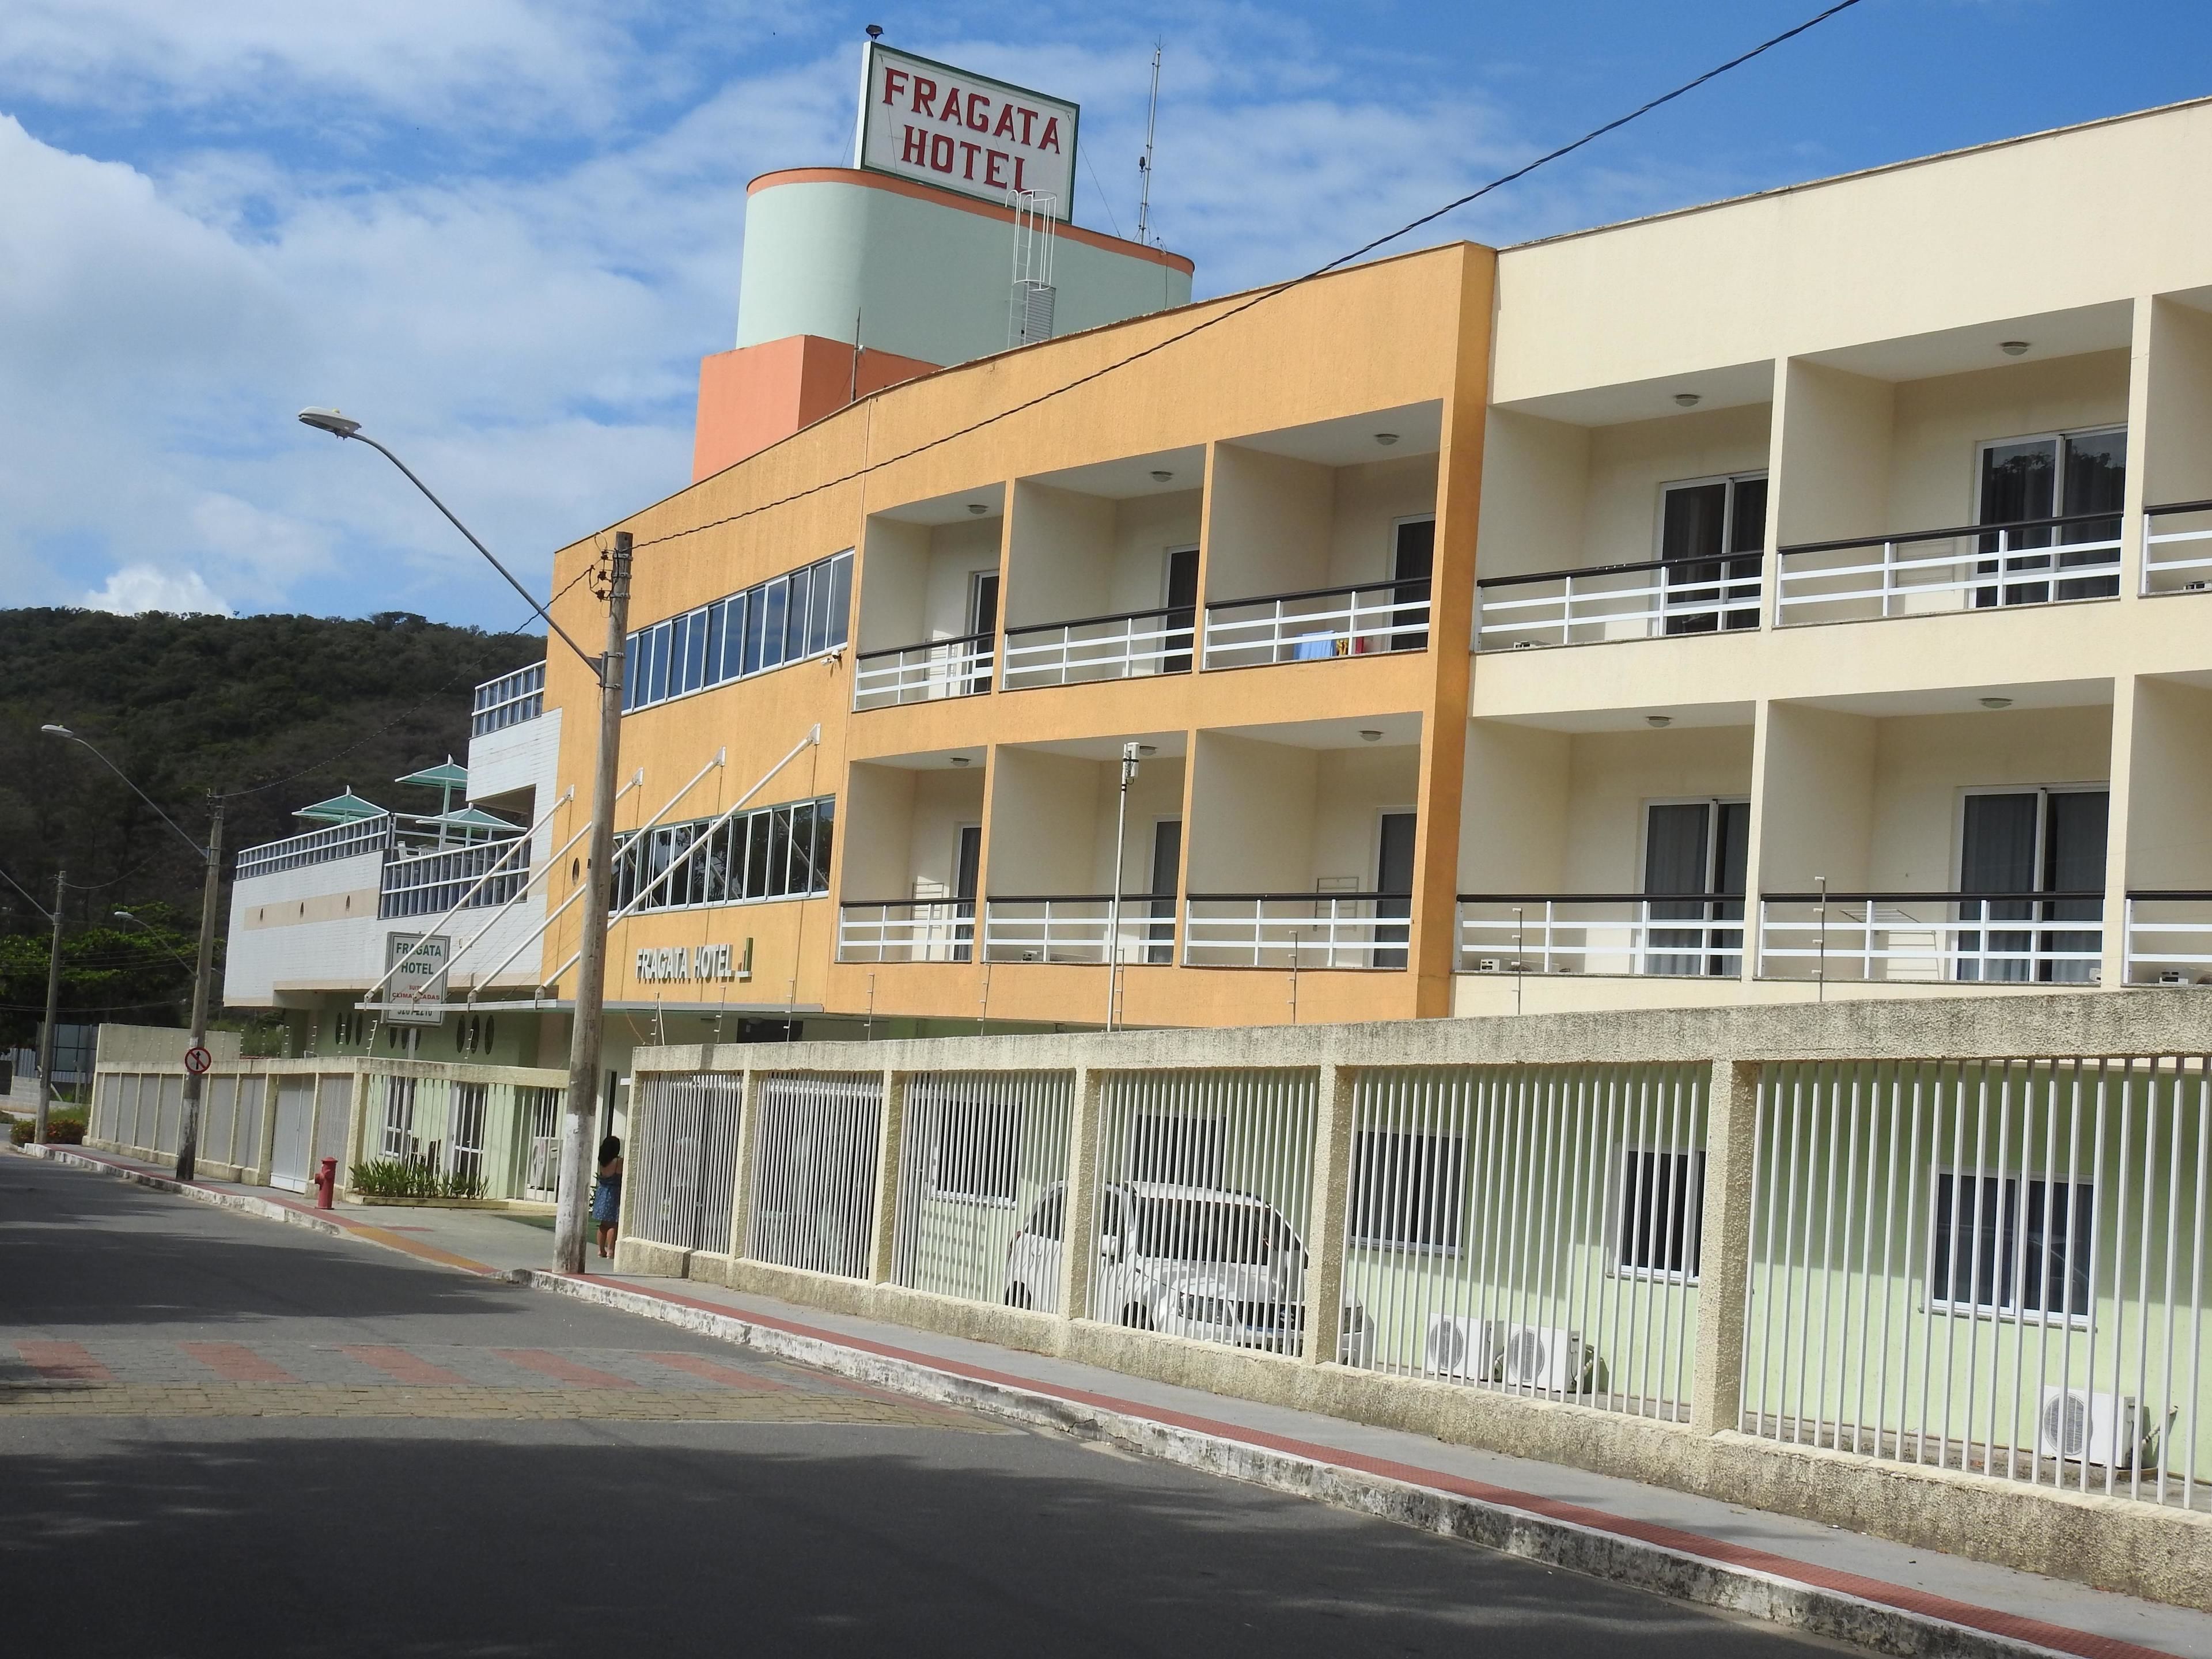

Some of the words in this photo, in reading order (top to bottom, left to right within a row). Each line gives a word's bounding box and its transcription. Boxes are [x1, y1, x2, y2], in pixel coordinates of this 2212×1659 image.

[882, 67, 1060, 154] FRAGATA
[901, 124, 1035, 195] HOTEL
[401, 962, 434, 975] HOTEL
[635, 948, 690, 979] FRAGATA
[694, 944, 734, 978] HOTEL
